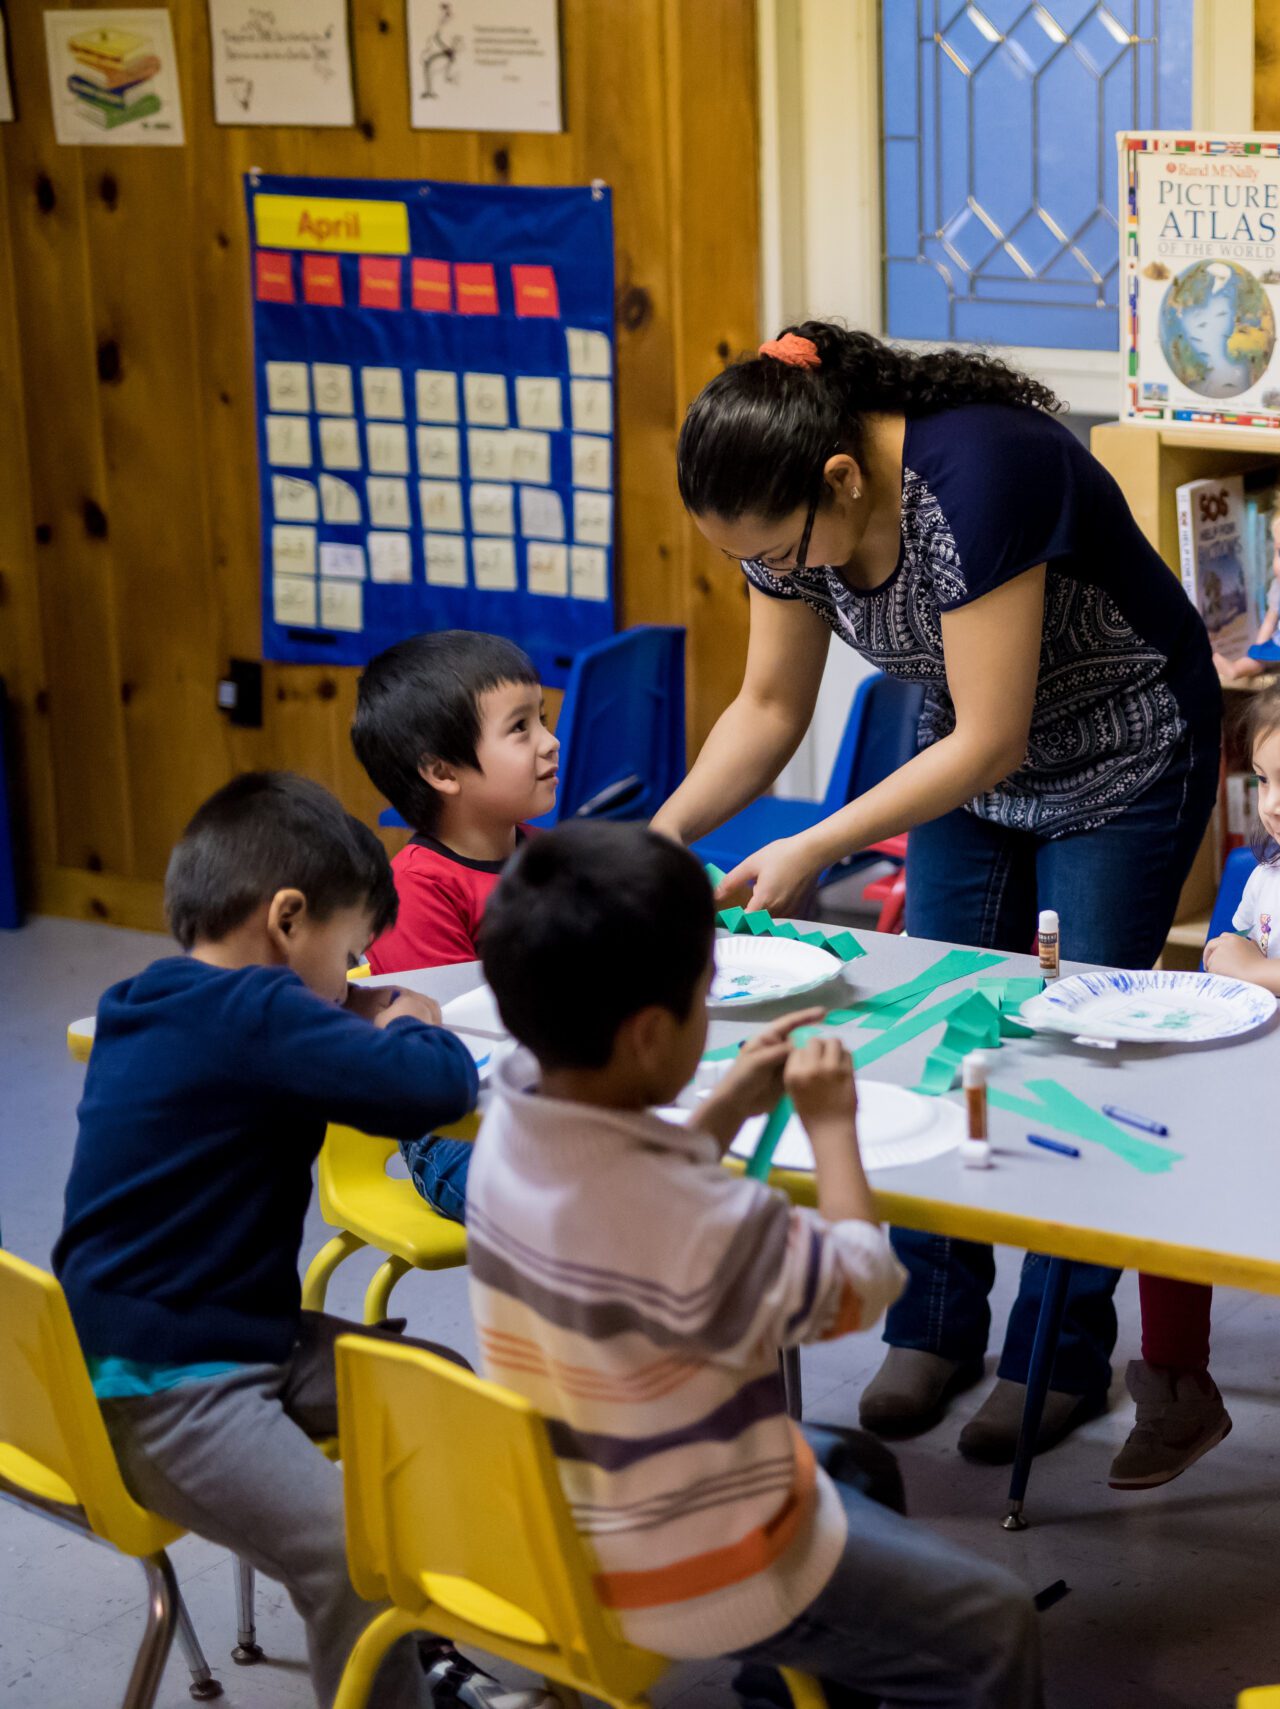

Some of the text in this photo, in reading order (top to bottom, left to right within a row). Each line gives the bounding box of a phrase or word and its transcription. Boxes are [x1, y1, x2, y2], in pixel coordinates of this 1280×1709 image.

[1178, 163, 1209, 177] Rand
[1158, 180, 1279, 209] PICTURE
[296, 211, 361, 241] April
[1159, 209, 1276, 242] ATLAS
[1158, 241, 1276, 259] OF THE WORLD
[1199, 489, 1230, 522] SOS
